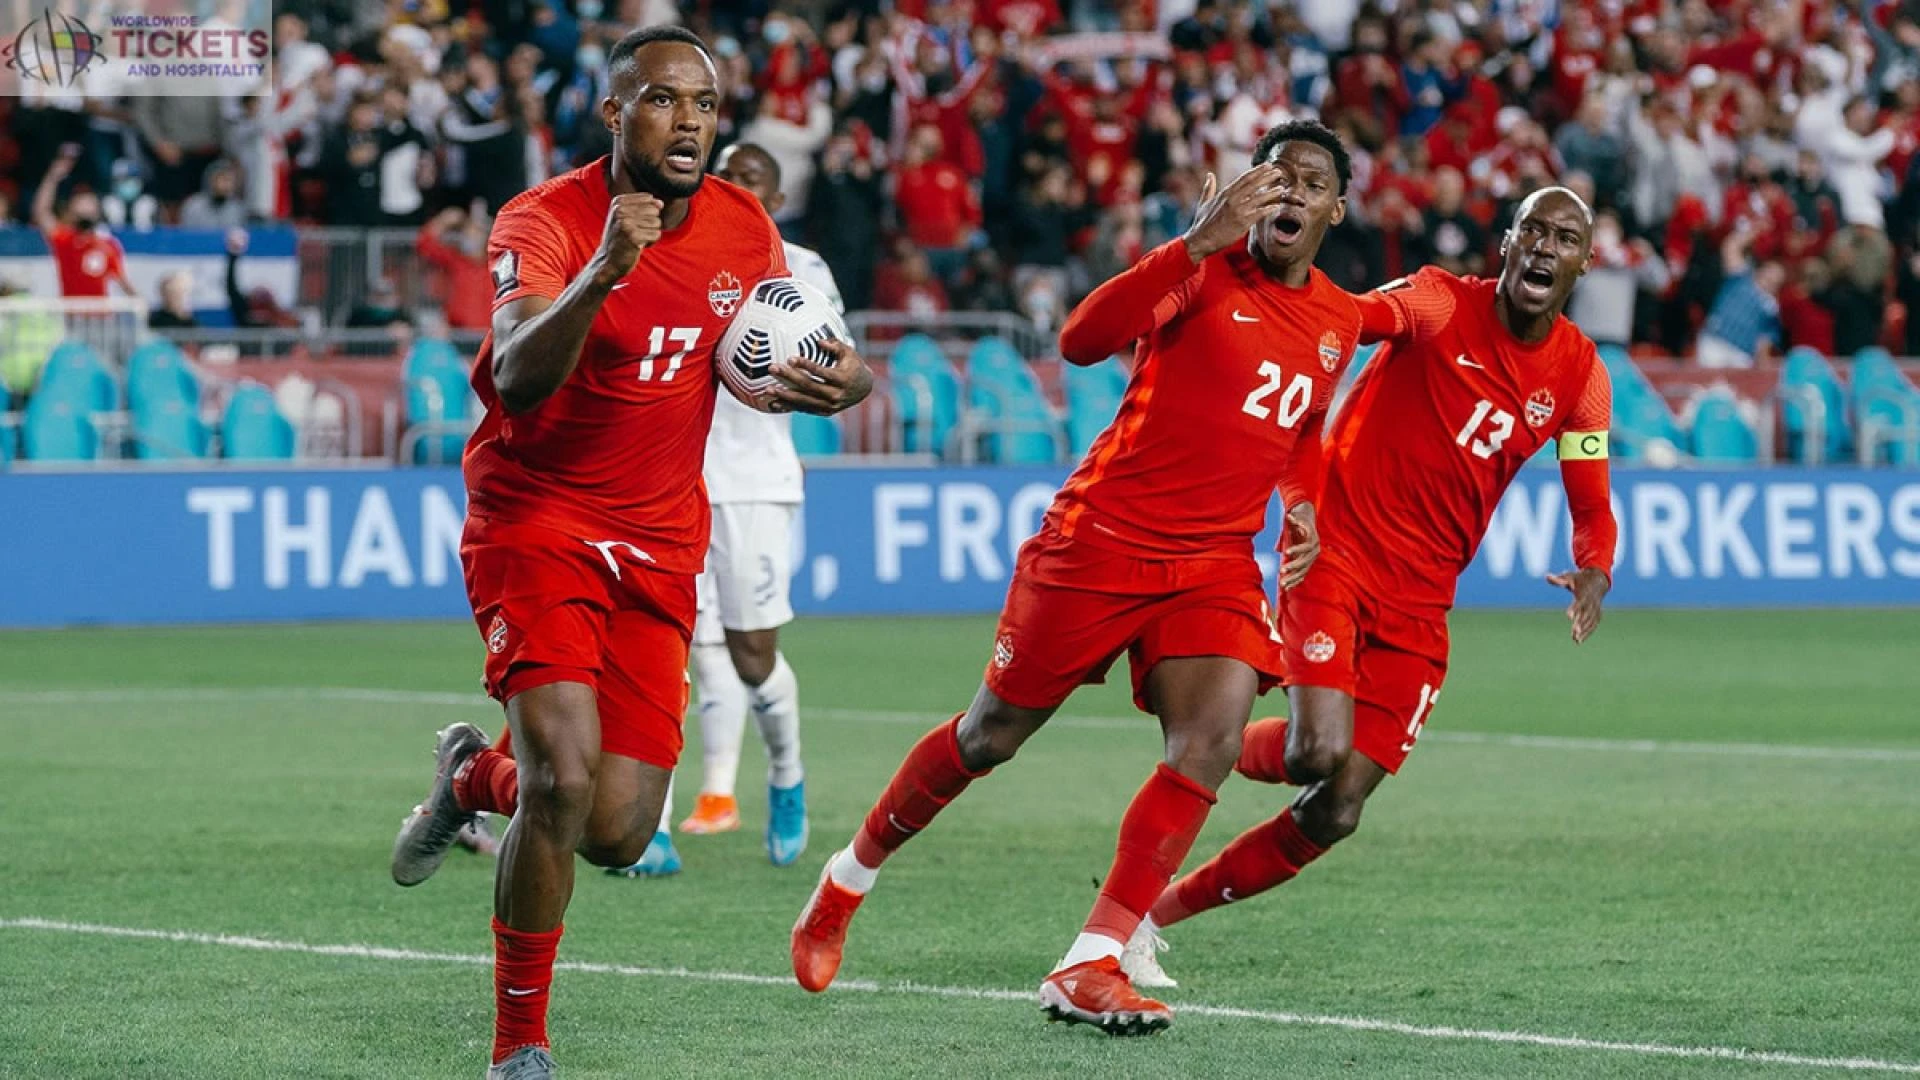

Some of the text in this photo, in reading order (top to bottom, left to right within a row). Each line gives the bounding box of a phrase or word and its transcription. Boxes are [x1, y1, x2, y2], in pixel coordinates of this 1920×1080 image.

[710, 290, 740, 300] CANADA
[638, 326, 702, 382] 17
[1242, 360, 1314, 429] 20
[1456, 399, 1515, 460] 13
[1580, 434, 1601, 456] C
